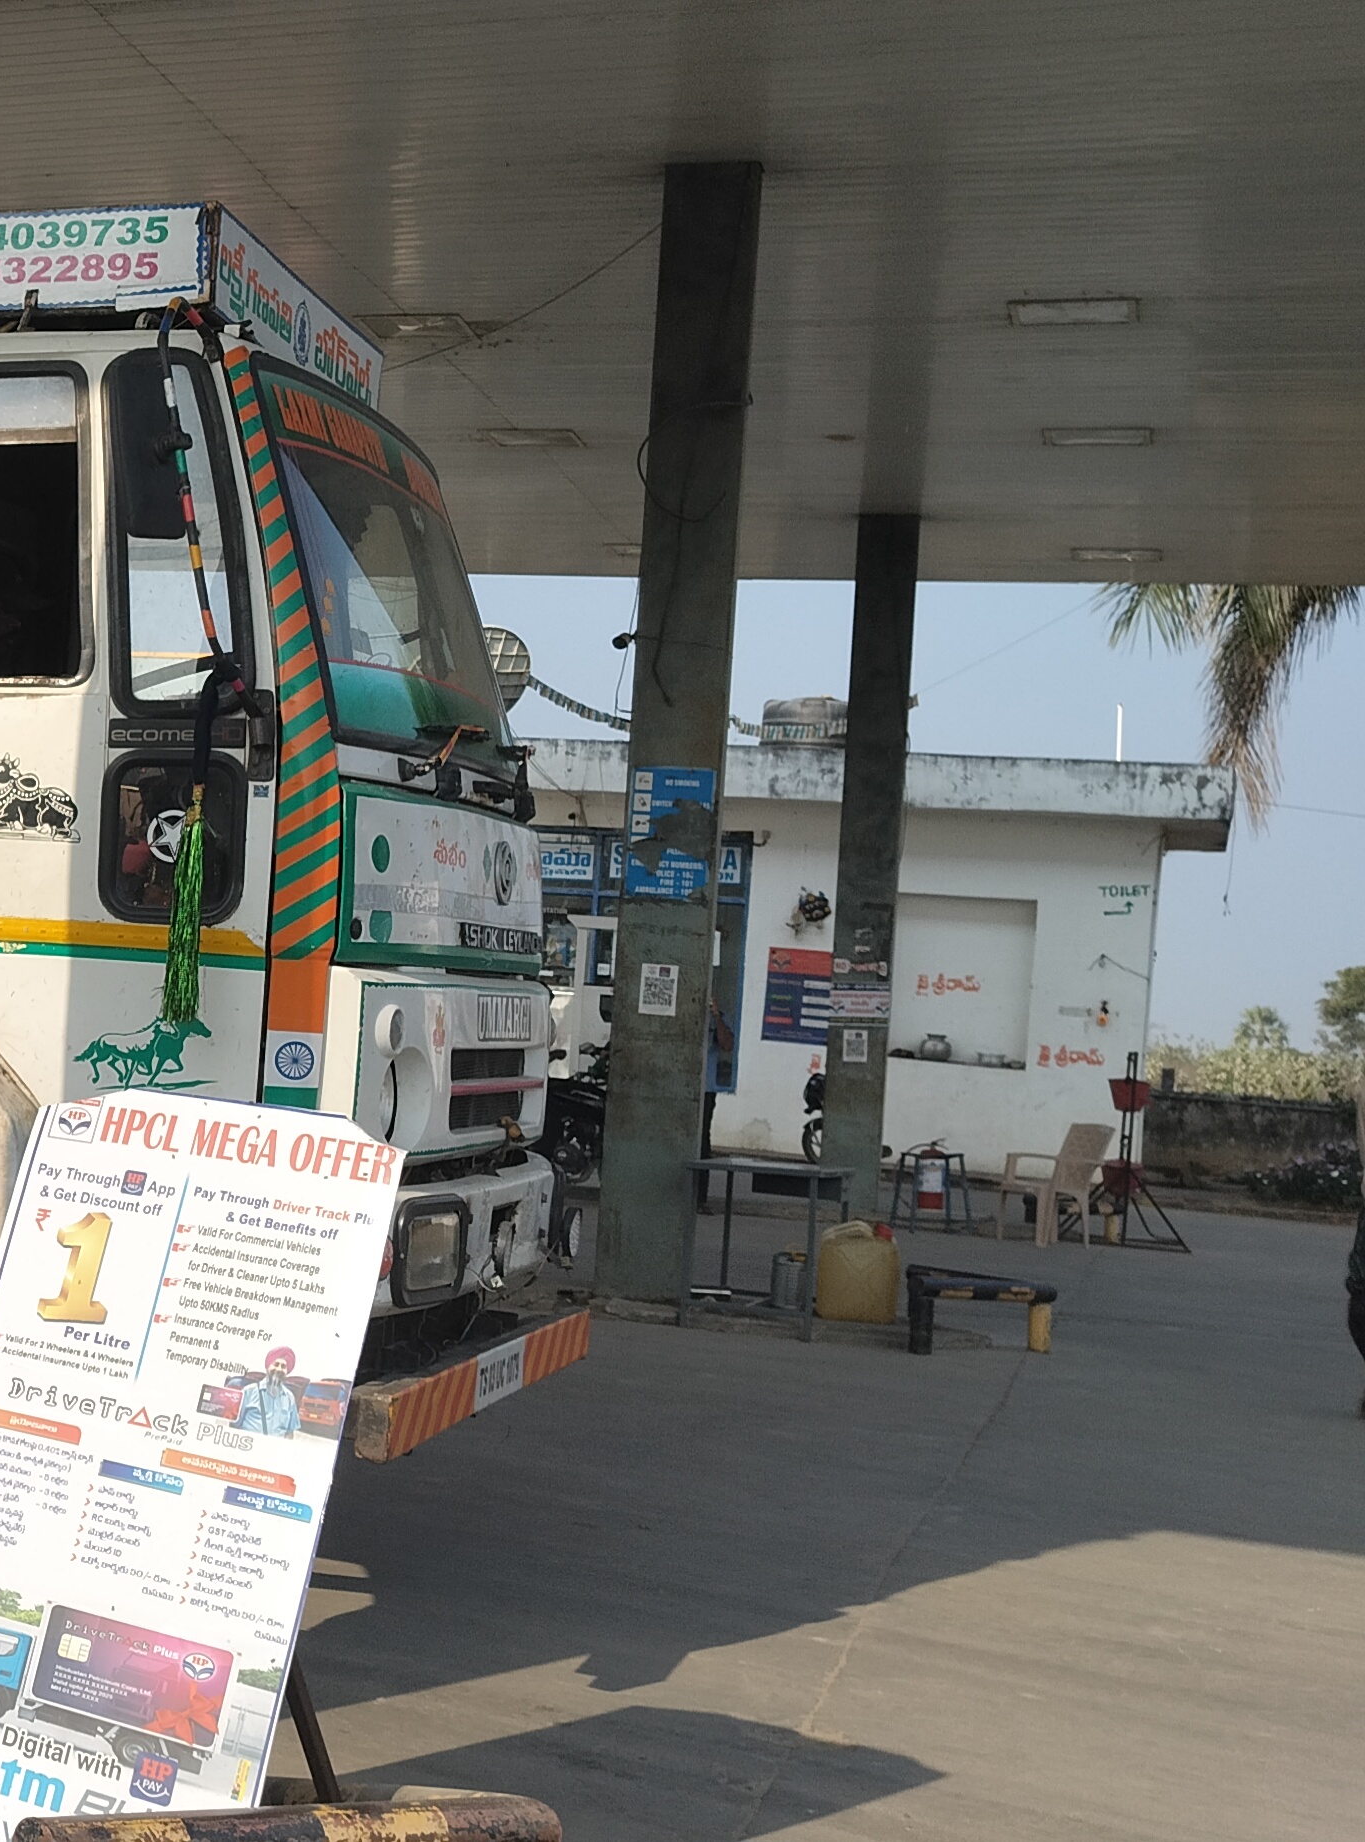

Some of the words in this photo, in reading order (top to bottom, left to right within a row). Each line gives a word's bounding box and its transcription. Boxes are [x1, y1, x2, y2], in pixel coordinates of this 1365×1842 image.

[110, 728, 195, 742] ecome
[1098, 883, 1152, 899] TOILET
[67, 1109, 87, 1121] HP
[99, 1105, 180, 1154] HPCL
[190, 1117, 278, 1169] MEGA
[288, 1132, 397, 1186] OFFER
[37, 1162, 62, 1180] Pay
[66, 1166, 121, 1189] Through
[126, 1171, 145, 1185] HP
[147, 1181, 176, 1199] App
[39, 1185, 50, 1198] &
[53, 1187, 77, 1203] Get
[80, 1191, 140, 1214] Discount
[142, 1203, 164, 1217] off
[193, 1185, 217, 1202] Pay
[220, 1189, 270, 1210] Through
[272, 1198, 311, 1216] Driver
[315, 1205, 351, 1223] Track
[197, 1224, 218, 1239] Valid
[218, 1228, 234, 1241] For
[234, 1231, 284, 1250] Commercial
[285, 1240, 322, 1257] Vehicles
[225, 1211, 235, 1223] &
[239, 1213, 262, 1228] Get
[264, 1217, 317, 1237] Benefits
[320, 1227, 340, 1241] off
[37, 1211, 113, 1325] 1
[192, 1242, 236, 1260] Accidental
[236, 1250, 278, 1268] Insurance
[279, 1257, 320, 1276] Coverage
[187, 1260, 201, 1272] for
[201, 1262, 227, 1277] Driver
[227, 1267, 235, 1278] &
[236, 1268, 269, 1285] Cleaner
[270, 1275, 291, 1289] Upto
[291, 1278, 299, 1290] 5
[299, 1279, 326, 1295] Lakhs
[178, 1295, 199, 1309] Upto
[199, 1299, 229, 1315] 50KMS
[230, 1305, 260, 1321] Radius
[183, 1277, 202, 1291] Free
[204, 1281, 233, 1298] Vehicle
[234, 1287, 282, 1306] Breakdown
[282, 1295, 339, 1317] Management
[64, 1325, 90, 1342] Per
[93, 1331, 131, 1350] Litre
[174, 1313, 215, 1331] Insurance
[216, 1321, 256, 1341] Coverage
[256, 1329, 273, 1342] For
[166, 1348, 209, 1370] Temporary
[209, 1357, 250, 1376] Disability
[196, 1421, 254, 1452] Plus
[1, 1725, 72, 1765] Digital
[77, 1752, 122, 1781] with
[139, 1756, 174, 1782] HP
[141, 1779, 163, 1793] PAY
